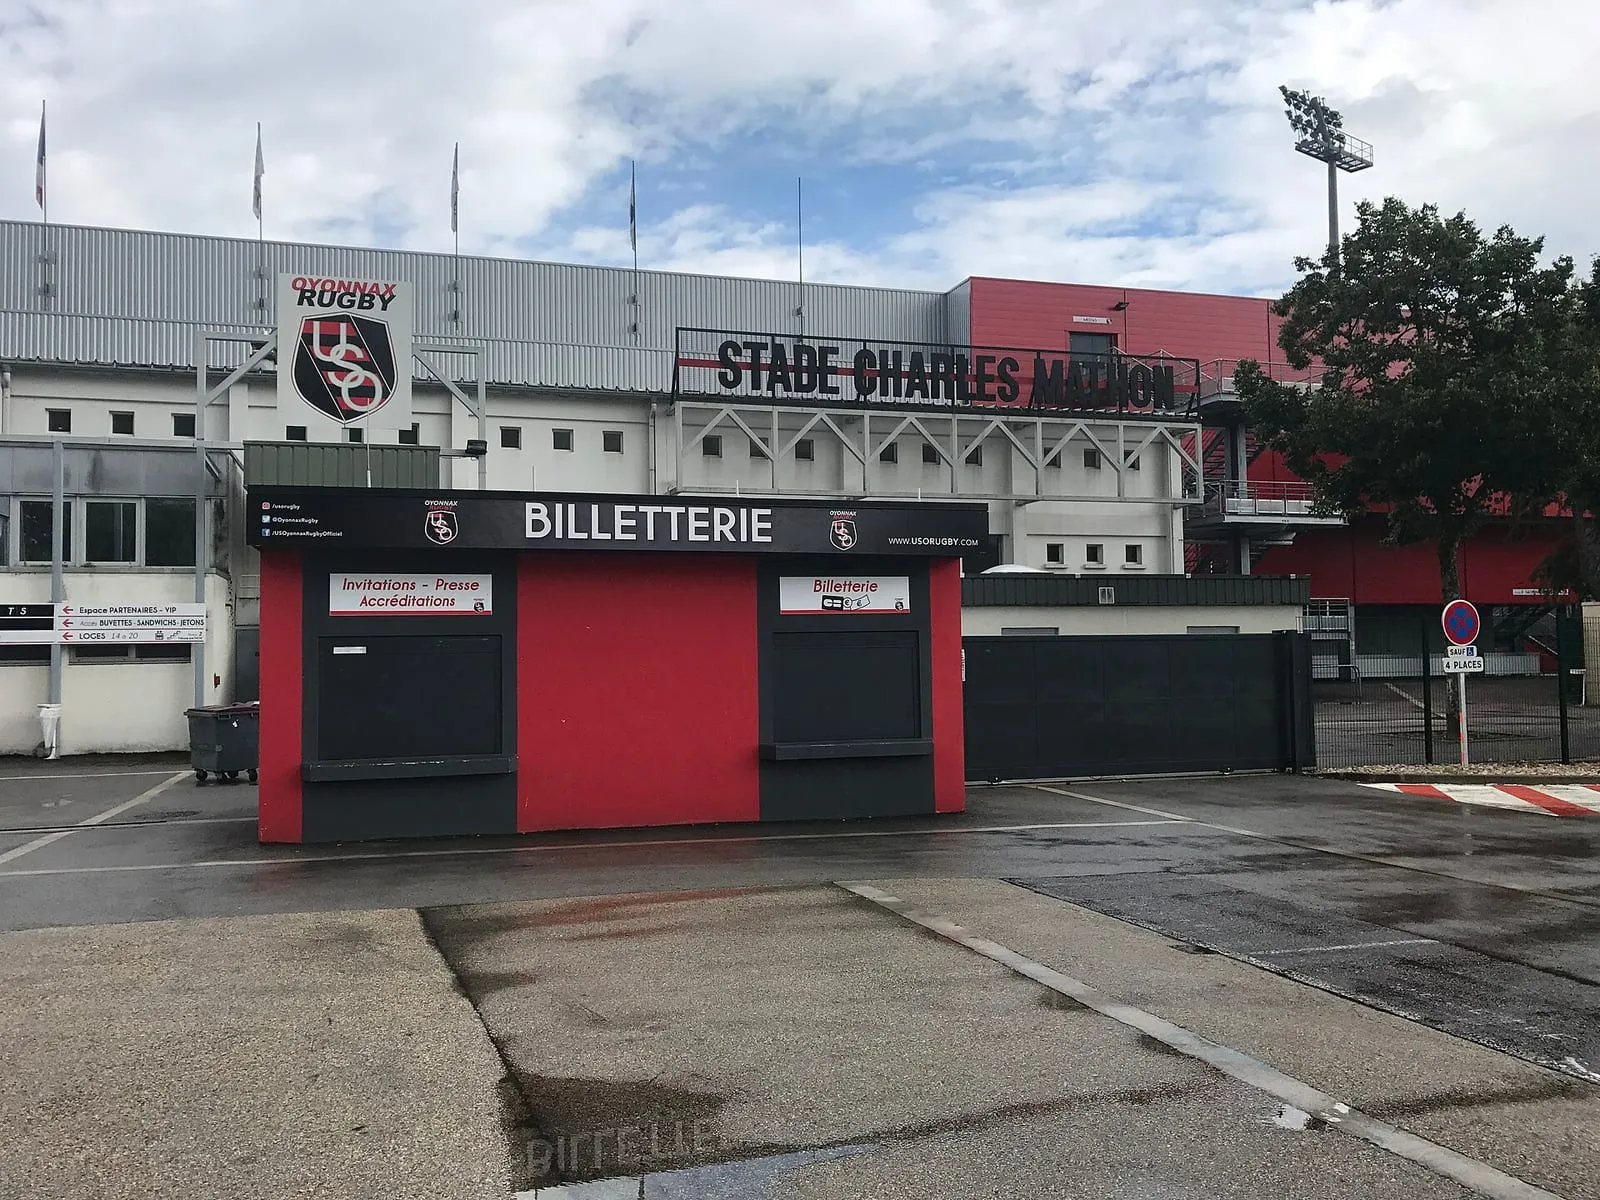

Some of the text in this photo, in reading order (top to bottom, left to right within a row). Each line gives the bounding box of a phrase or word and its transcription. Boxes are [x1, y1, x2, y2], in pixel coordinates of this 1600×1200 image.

[291, 277, 397, 296] OYONNAX
[297, 289, 397, 311] RUGBY
[718, 340, 1174, 409] STADE CHARLES MATHON
[525, 502, 772, 542] BILLETTERIE
[888, 537, 979, 546] WWW.USORUGBY.COM
[342, 578, 416, 591] Invitations
[435, 578, 480, 591] Presse
[813, 579, 878, 593] Billetterie
[359, 594, 456, 607] Accréditations
[79, 607, 108, 615] Espace
[180, 619, 205, 627] JETONS
[1445, 660, 1482, 669] 4 PLACES
